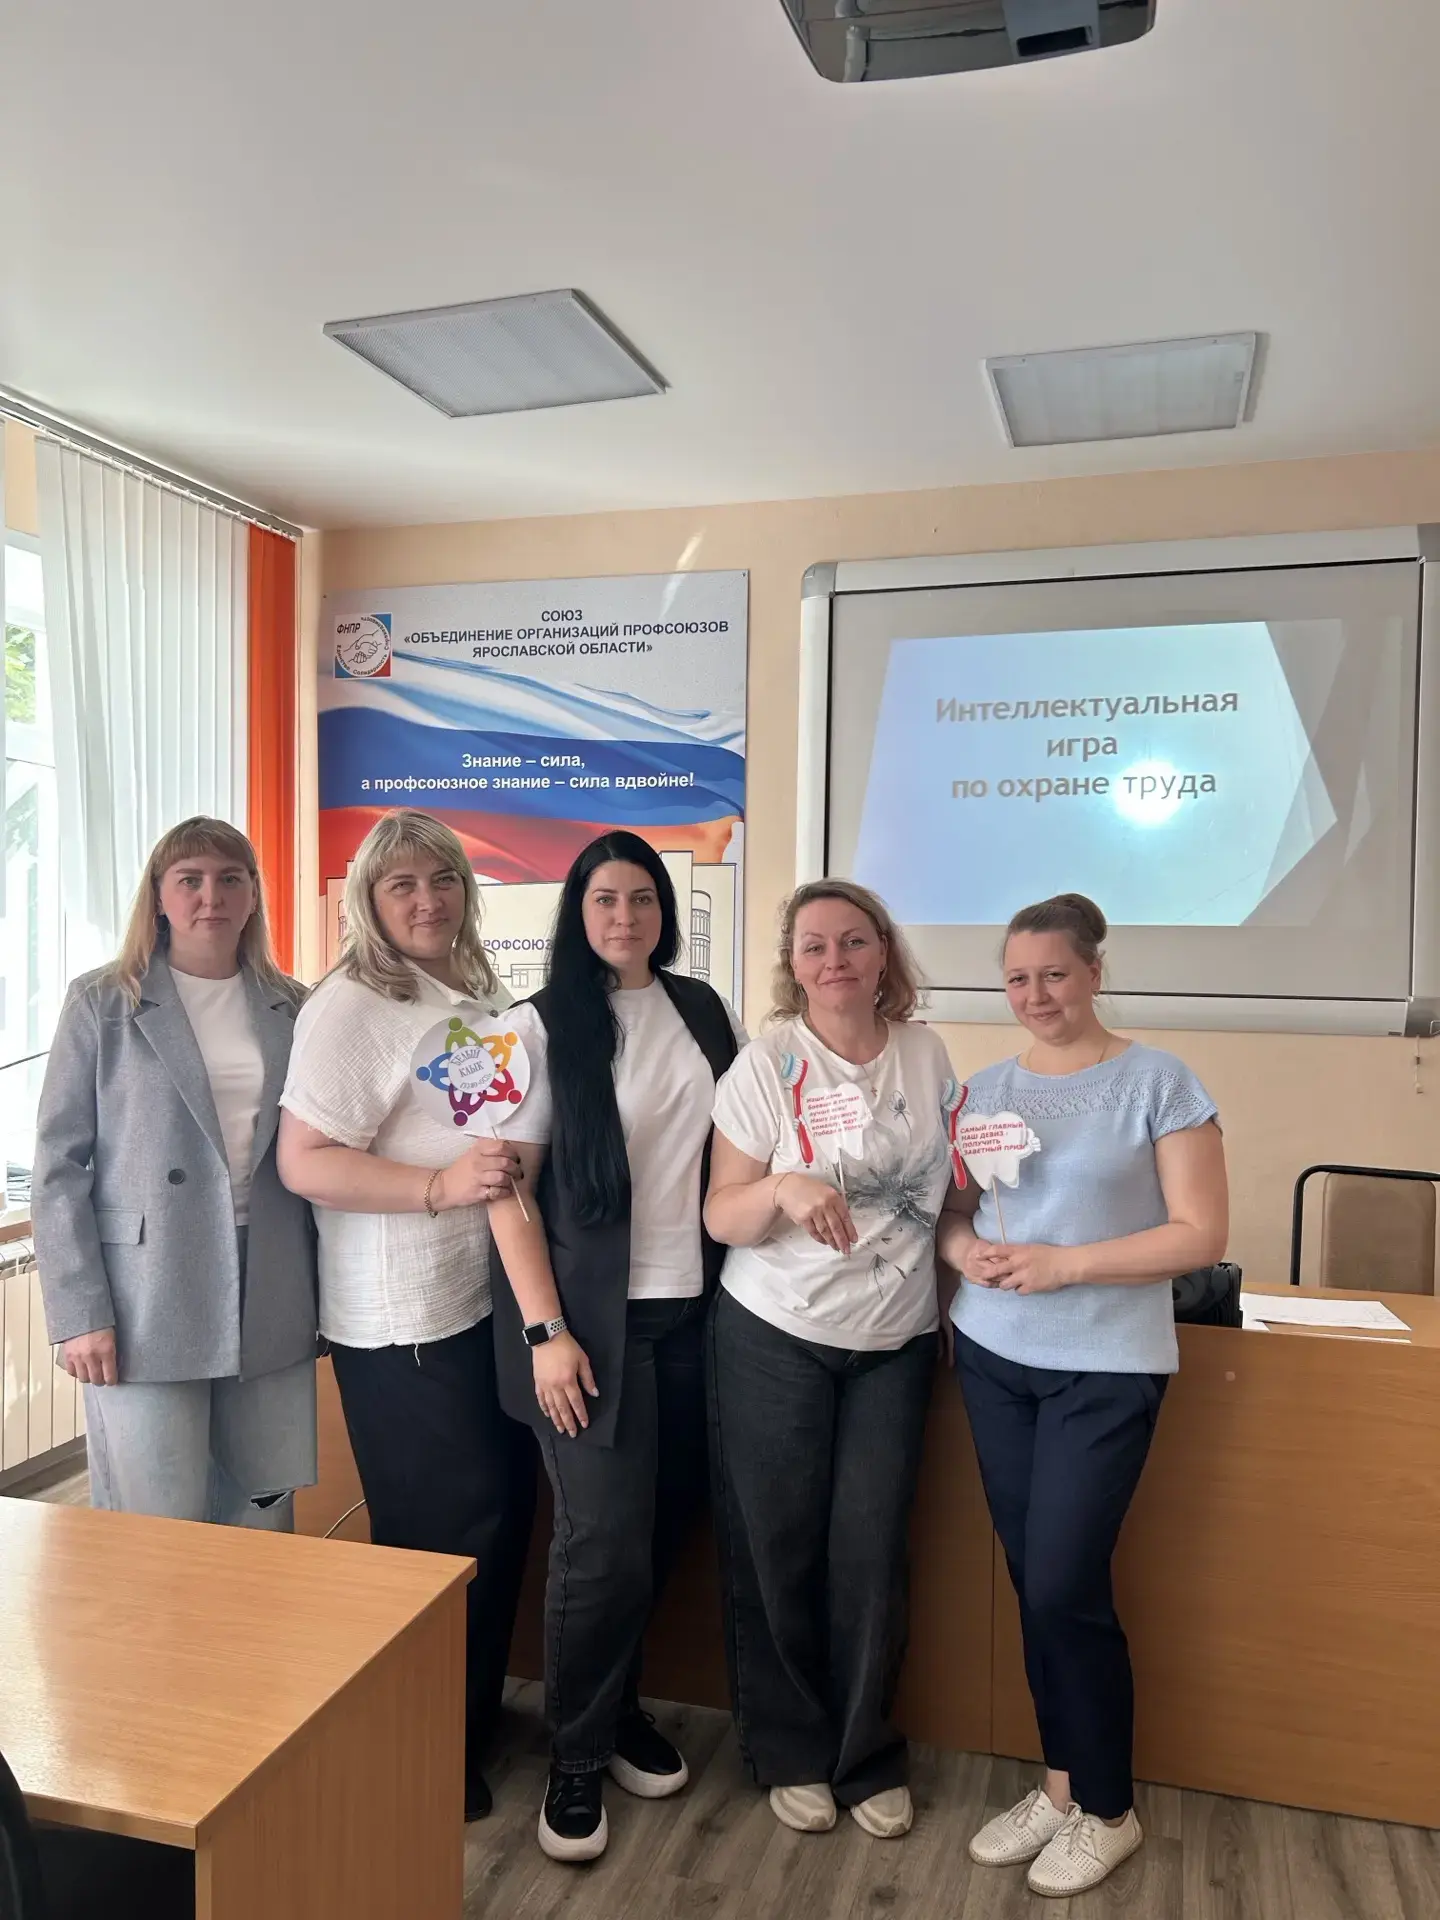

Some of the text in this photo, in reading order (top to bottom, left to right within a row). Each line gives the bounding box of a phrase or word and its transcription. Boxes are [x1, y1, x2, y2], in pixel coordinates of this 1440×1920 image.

[541, 609, 583, 622] СОЮЗ
[336, 622, 361, 635] ФНПР
[404, 620, 729, 644] «ОБЪЕДИНЕНИЕ ОРГАНИЗАЦИЙ ПРОФСОЮЗОВ
[472, 641, 653, 658] ЯРОСЛАВСКОЙ ОБЛАСТИ»
[935, 692, 1239, 723] Интеллектуальная
[1047, 735, 1118, 761] игра
[461, 753, 522, 768] Знание
[540, 755, 586, 769] сила,
[361, 779, 370, 790] а
[374, 775, 488, 793] профсоюзное
[492, 777, 551, 789] знание
[569, 775, 610, 788] сила
[615, 772, 694, 790] вдвойне!
[952, 773, 1217, 802] по охране труда
[483, 938, 554, 951] РОФСОЮЗ
[450, 1047, 481, 1066] БЕЛЫЙ
[458, 1060, 485, 1078] КЛЫК
[960, 1122, 1024, 1134] САМЫЙ ГЛАВНЫЙ
[980, 1131, 1004, 1140] ДЕВИЗ
[962, 1139, 1001, 1149] ПОЛУЧИТЬ
[964, 1146, 1002, 1156] ЗАВЕТНЫЙ
